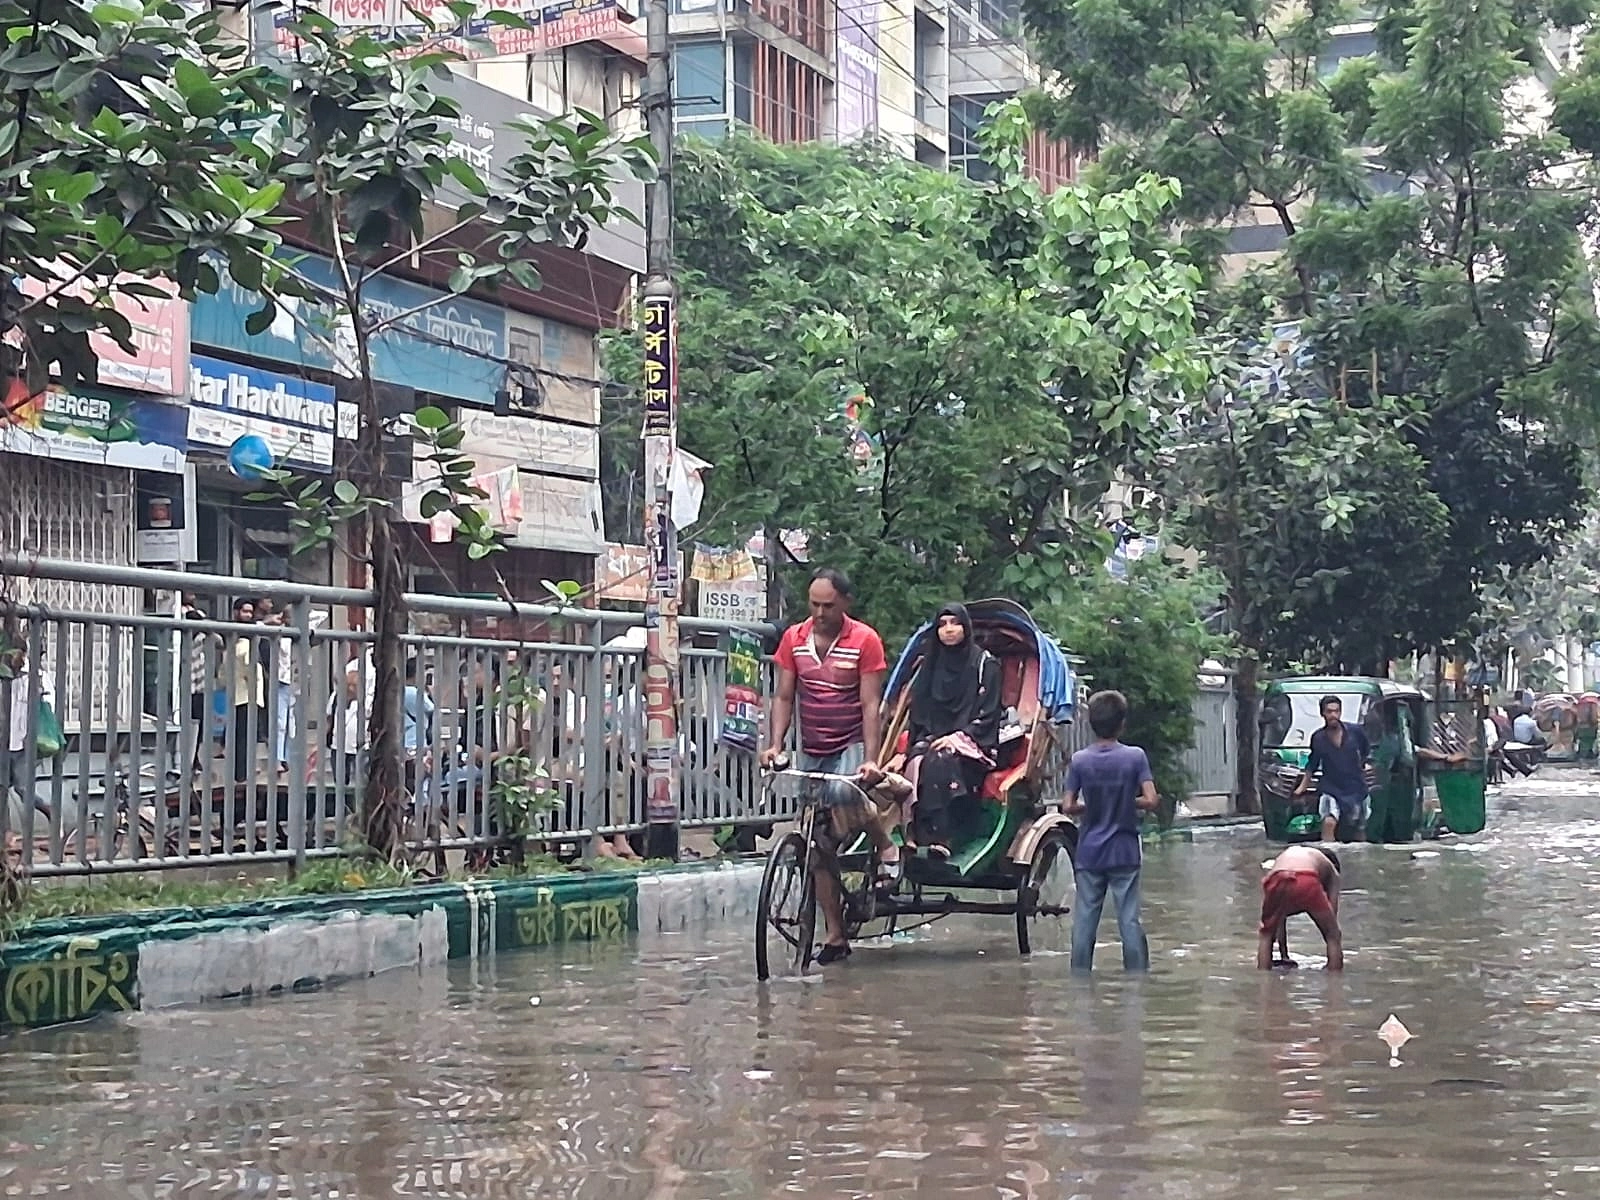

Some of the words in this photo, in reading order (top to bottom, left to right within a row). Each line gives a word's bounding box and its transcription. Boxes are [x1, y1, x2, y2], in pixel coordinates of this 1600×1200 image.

[44, 391, 112, 422] BERGER
[189, 363, 228, 405] tar
[228, 372, 336, 429] Hardware
[705, 591, 740, 607] ISSB
[5, 936, 134, 1026] কোচিং
